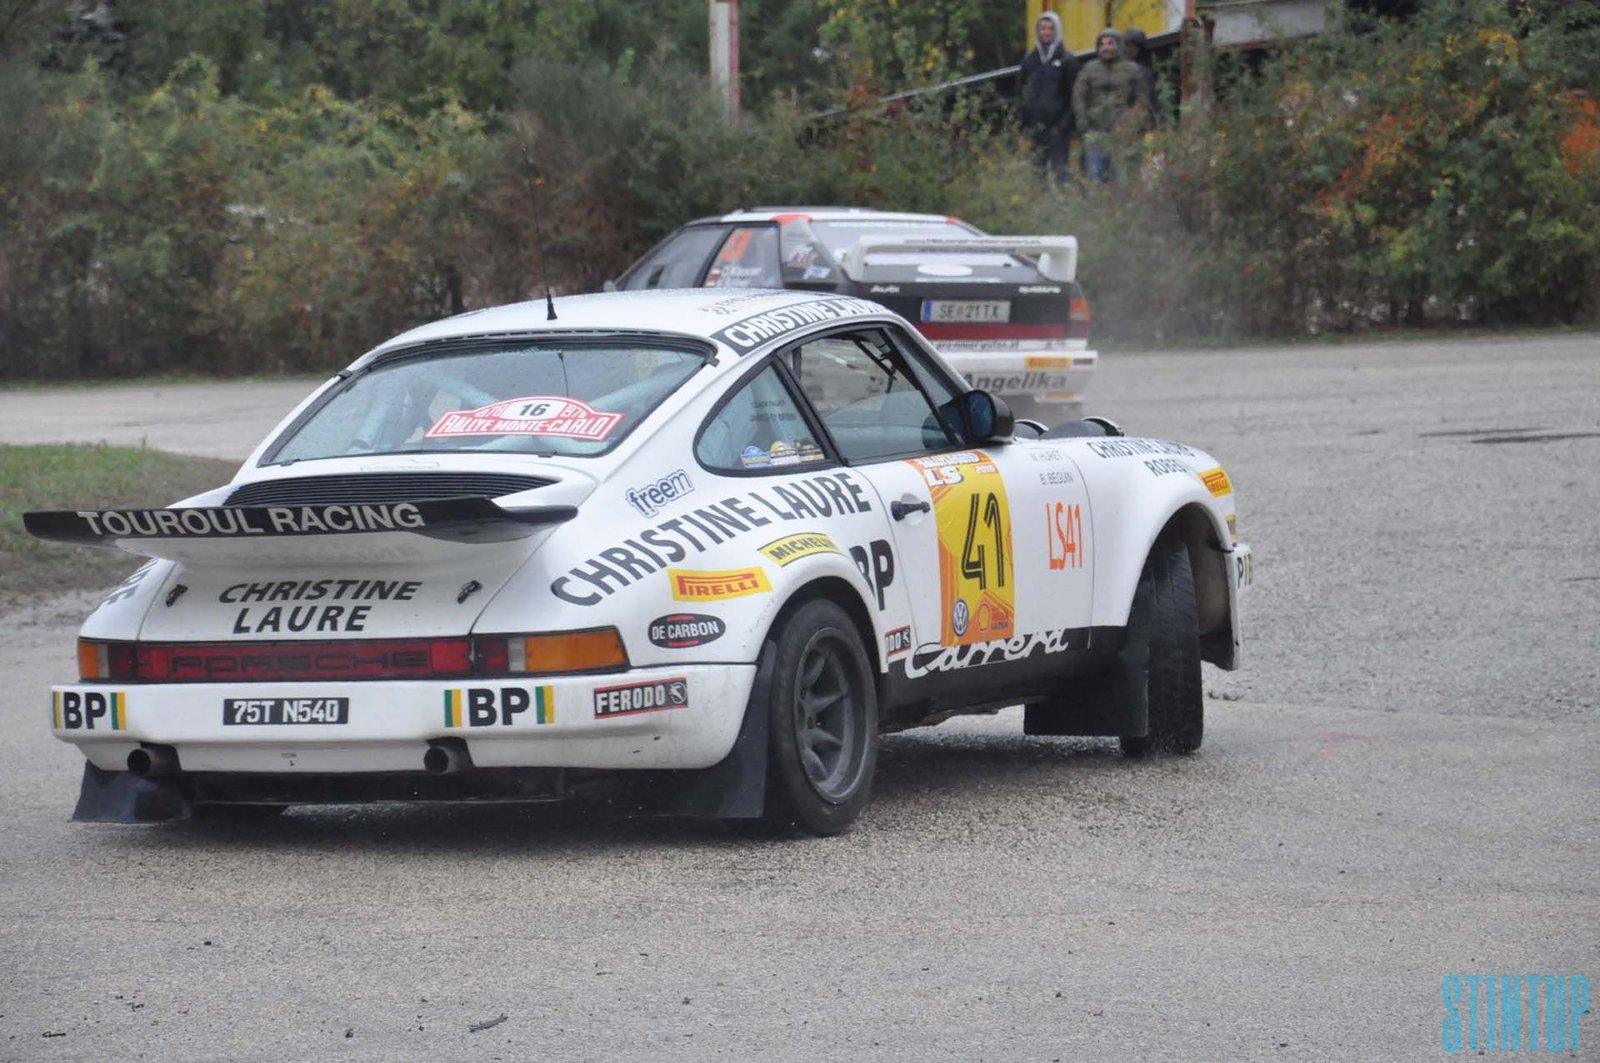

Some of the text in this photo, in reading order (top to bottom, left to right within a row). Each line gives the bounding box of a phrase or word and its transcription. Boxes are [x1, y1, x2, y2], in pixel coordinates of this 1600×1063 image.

[724, 300, 840, 348] CHRISTINE
[519, 403, 550, 417] 16
[627, 471, 693, 516] freem
[77, 502, 427, 536] TOUROUL RACING
[551, 472, 872, 607] CHRISTINE LAURE
[961, 491, 1005, 590] 41
[218, 579, 422, 604] CHRISTINE
[676, 572, 760, 596] PIRELLI
[233, 605, 372, 634] LAURE
[652, 620, 720, 640] DE CARBON
[169, 650, 428, 673] PORSCHE
[62, 691, 107, 730] BP
[232, 700, 340, 723] 75T N540
[467, 687, 531, 727] BP
[596, 684, 667, 714] FERODO
